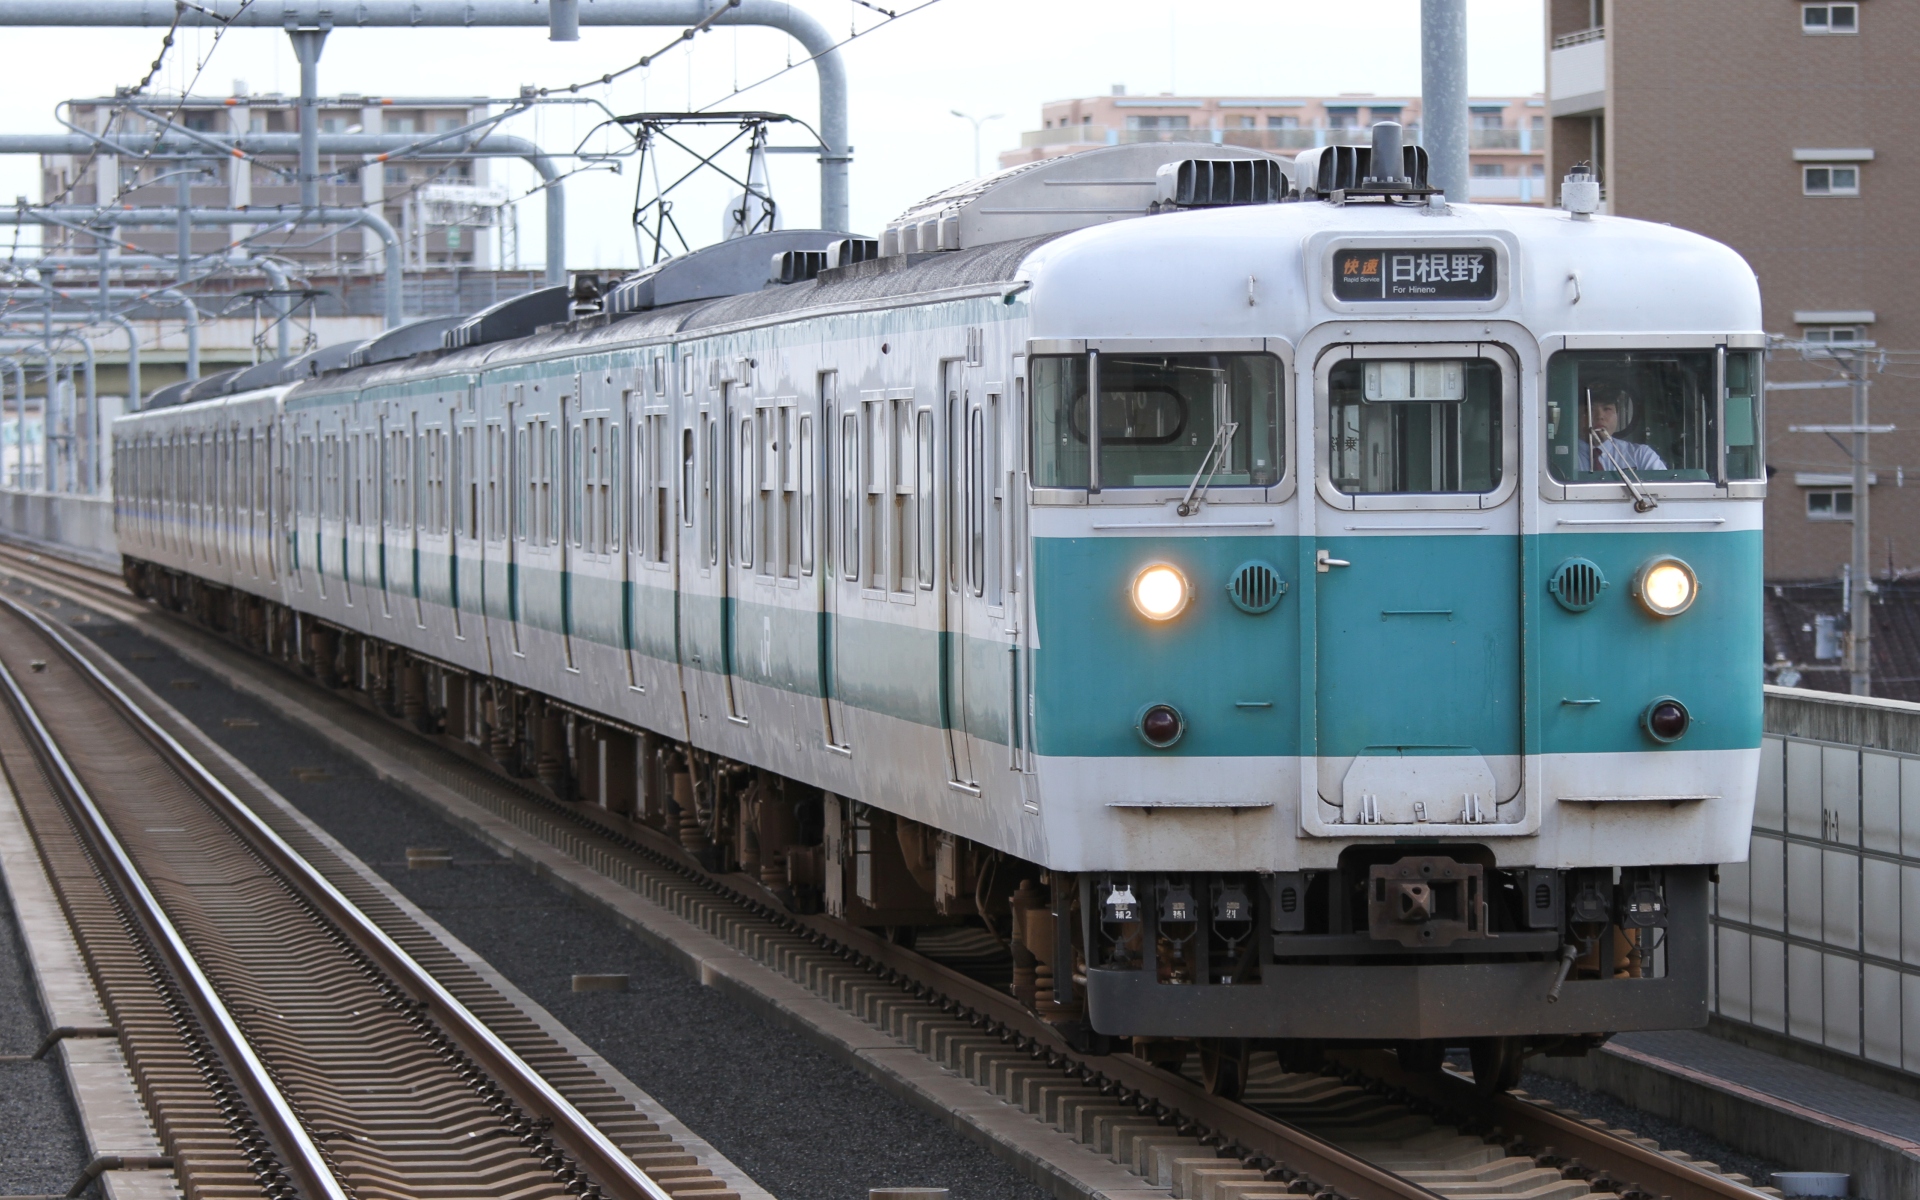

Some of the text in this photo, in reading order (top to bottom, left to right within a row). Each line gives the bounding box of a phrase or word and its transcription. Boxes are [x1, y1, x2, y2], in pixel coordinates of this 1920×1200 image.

[1343, 258, 1380, 275] 快速
[1392, 253, 1485, 283] 日根野
[1392, 285, 1436, 294] For Hineno
[760, 616, 772, 678] JR
